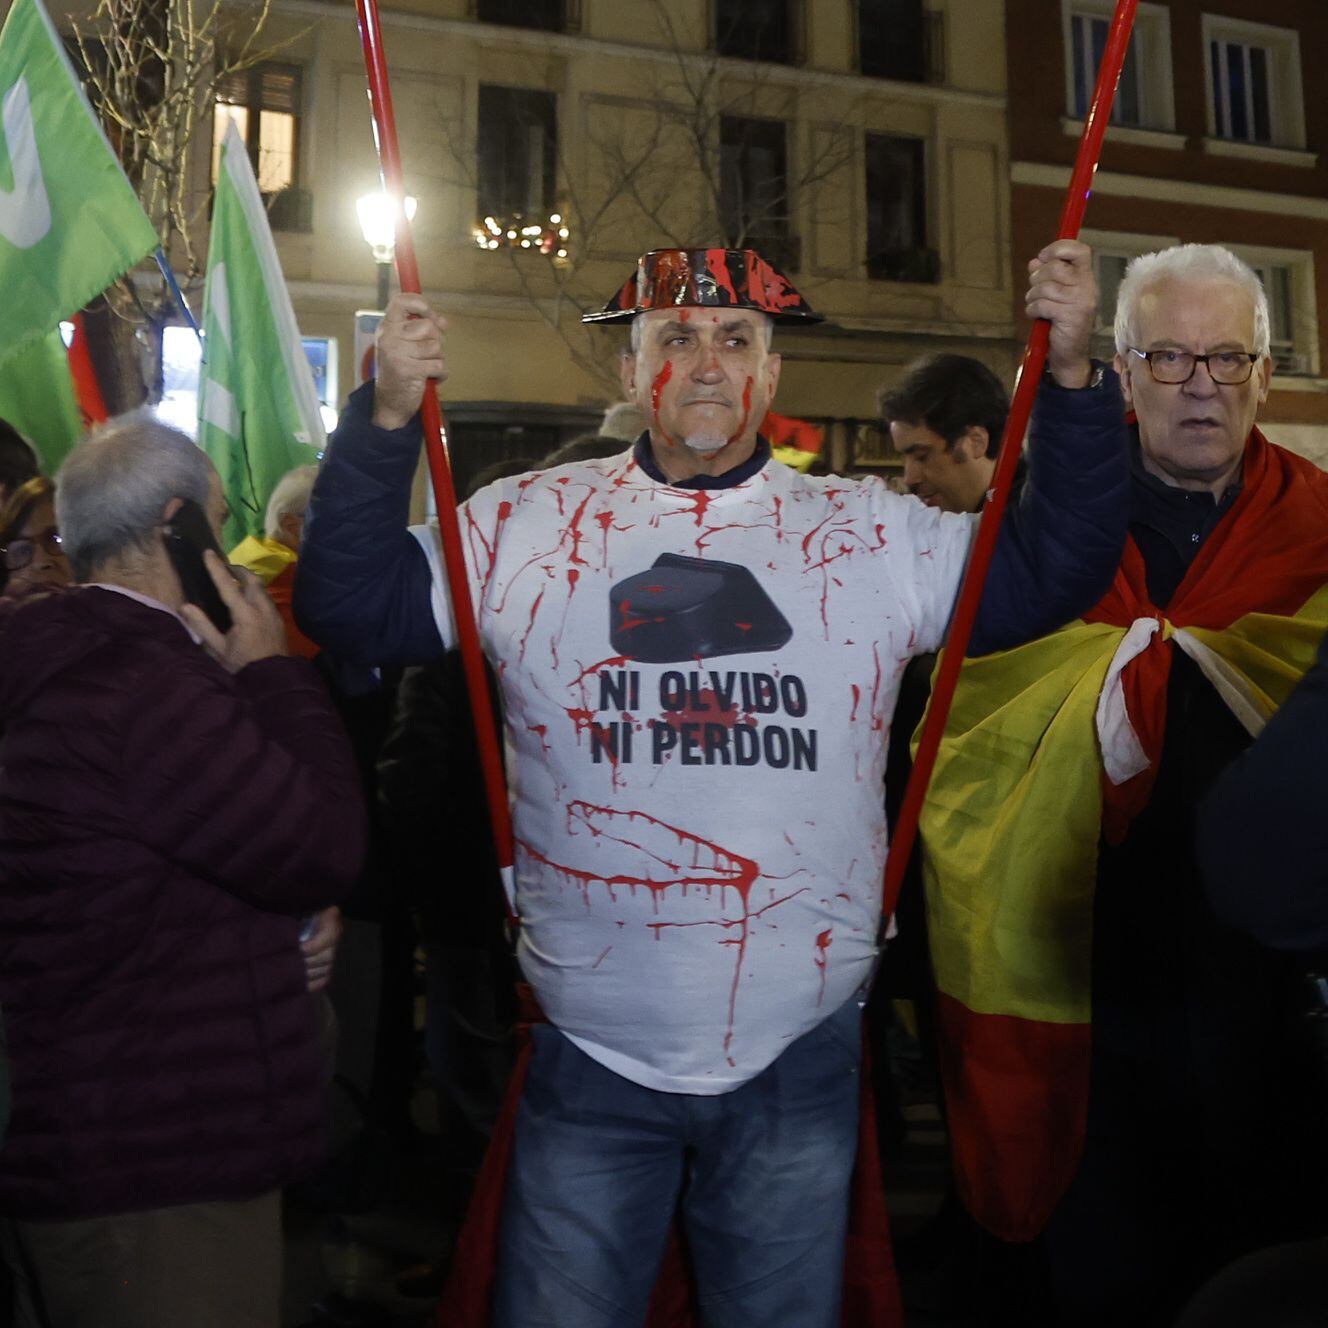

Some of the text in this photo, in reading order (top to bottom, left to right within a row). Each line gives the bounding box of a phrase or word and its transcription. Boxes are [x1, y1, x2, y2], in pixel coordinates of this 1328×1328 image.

[598, 670, 808, 718] NI OLVIDO
[591, 720, 818, 772] NI PERDON
